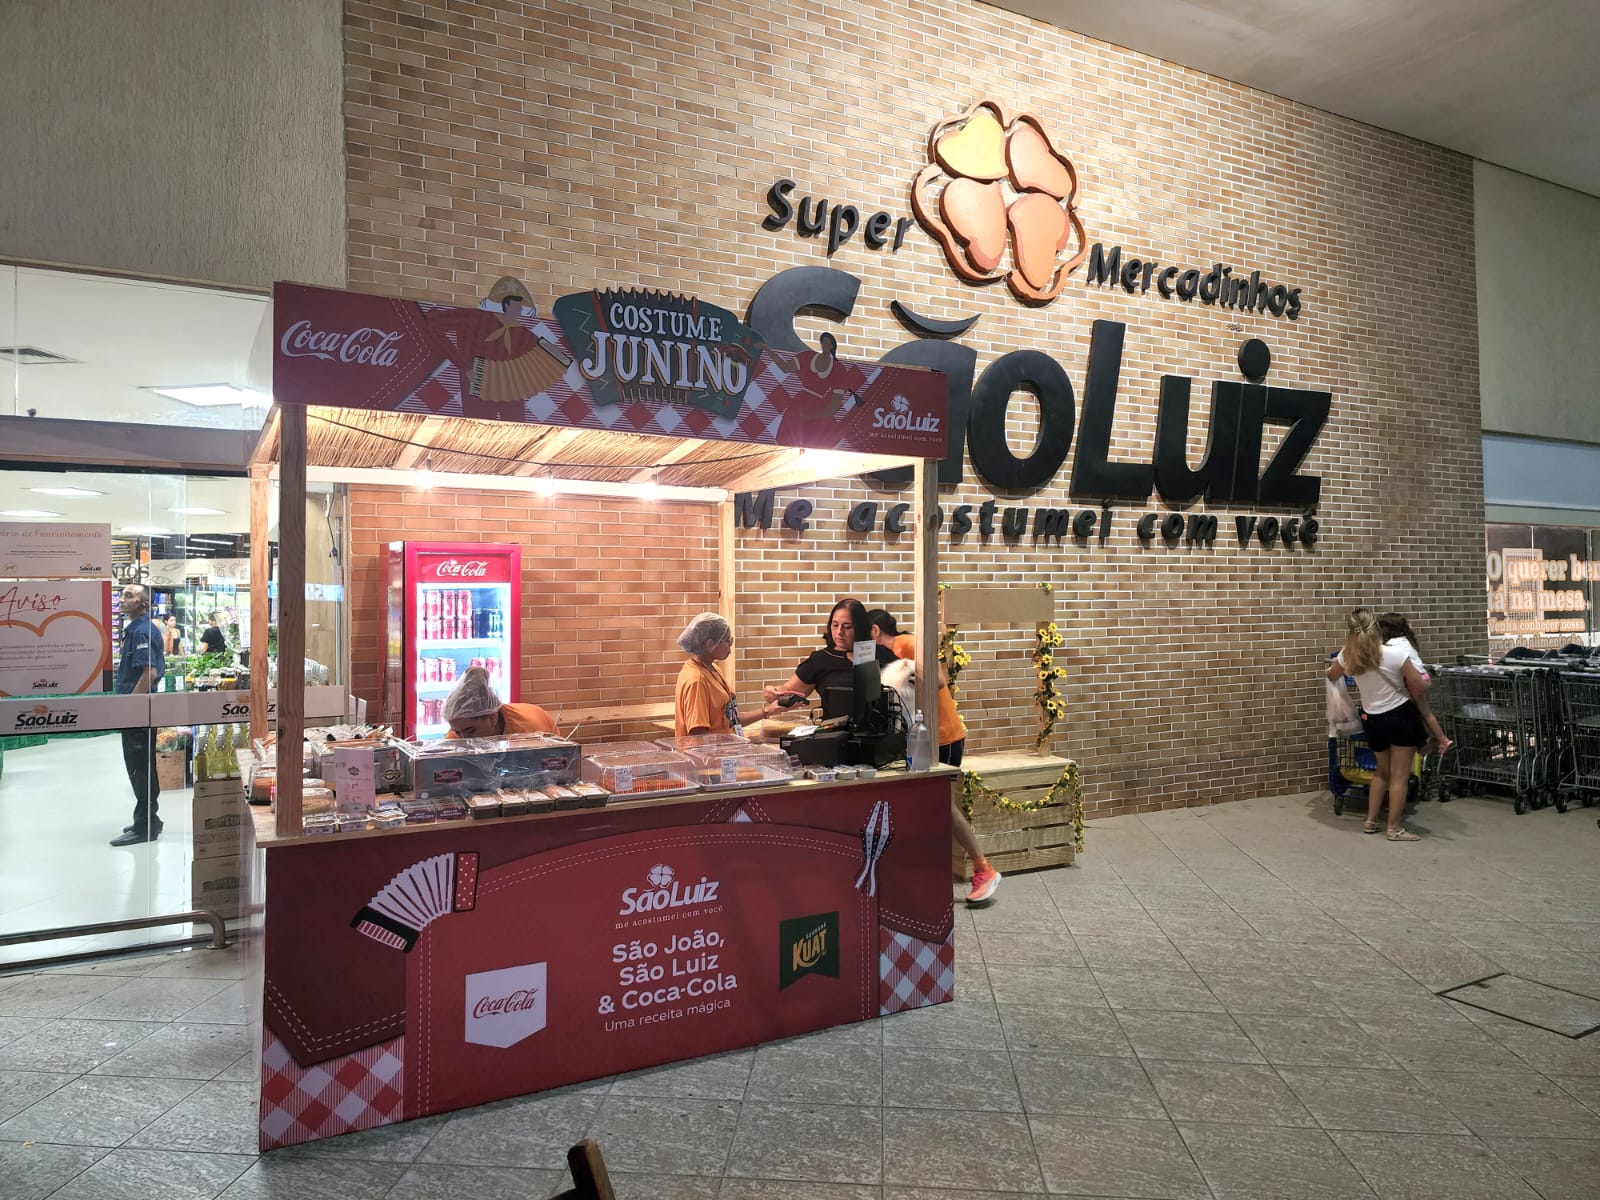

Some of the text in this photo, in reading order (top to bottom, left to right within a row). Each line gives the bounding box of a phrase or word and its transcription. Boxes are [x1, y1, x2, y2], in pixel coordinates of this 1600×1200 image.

[761, 178, 912, 256] Super
[1087, 243, 1303, 319] Mercadinhos
[609, 302, 722, 343] COSTUME
[280, 319, 406, 367] Coca-Cola
[579, 330, 748, 396] JUNINO
[735, 489, 1319, 544] Me acstumei com você
[436, 560, 490, 577] Coca-Cola
[1487, 551, 1502, 580] O
[1507, 559, 1568, 586] querer
[0, 586, 67, 627] Aviso
[1510, 589, 1535, 612] na
[1519, 618, 1559, 633] conhecer
[619, 876, 720, 916] SãoLuiz
[682, 910, 701, 919] com
[612, 928, 725, 963] São João,
[792, 928, 827, 972] KUAT
[619, 951, 719, 986] São Luiz
[472, 987, 539, 1019] Coca-Cola
[598, 972, 738, 1015] & Coca-Cola
[605, 999, 731, 1032] Uma receita mágica
